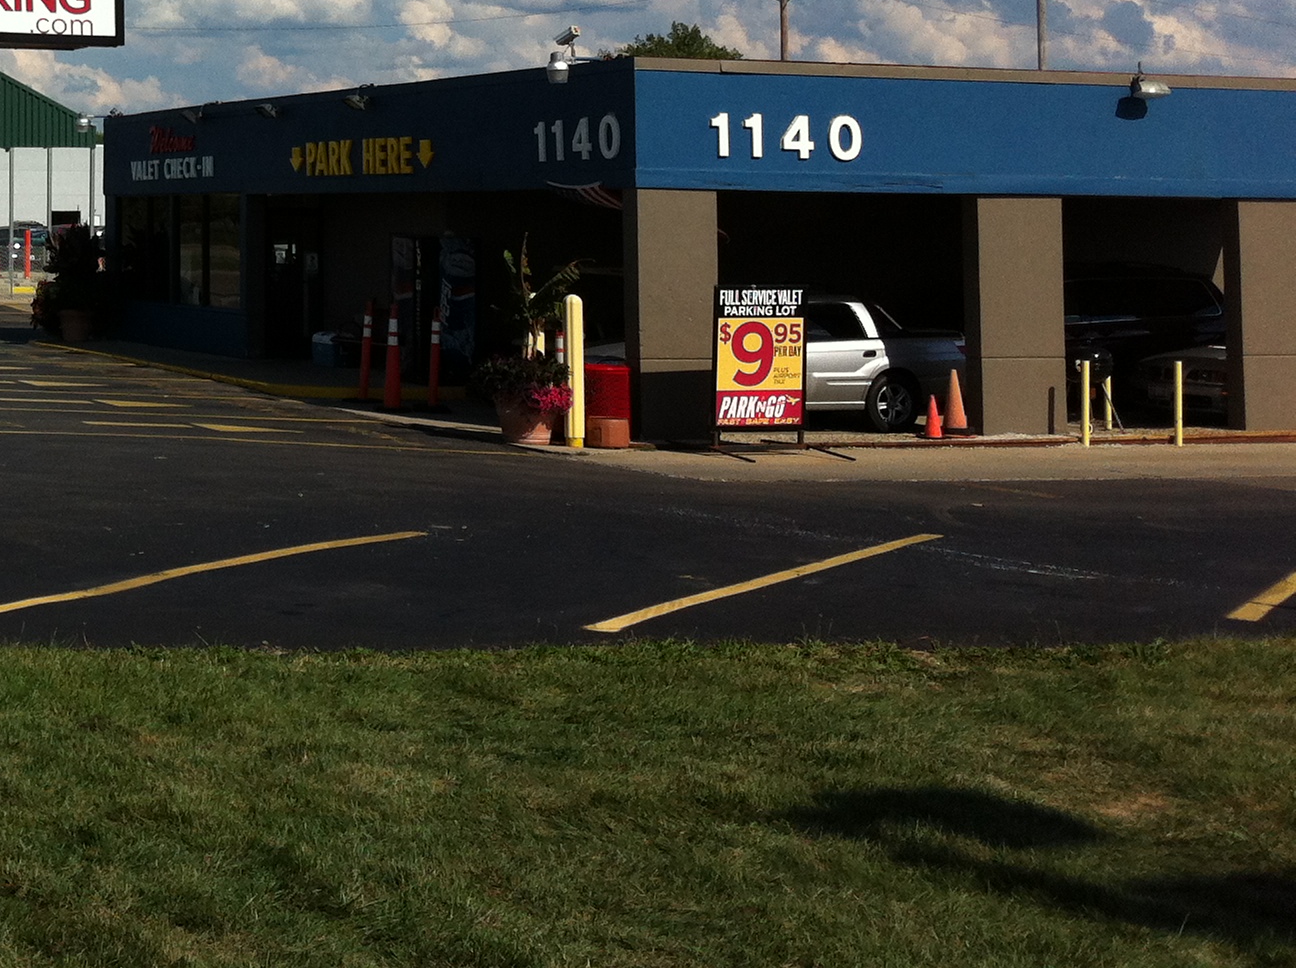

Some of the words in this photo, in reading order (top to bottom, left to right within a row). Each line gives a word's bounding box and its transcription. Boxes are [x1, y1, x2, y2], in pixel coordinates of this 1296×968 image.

[533, 113, 621, 163] 1140
[709, 112, 862, 162] 1140
[305, 140, 353, 176] PARK
[362, 137, 414, 175] HERE
[130, 160, 160, 181] VALET
[720, 290, 740, 305] FULL
[741, 290, 777, 305] SERVICE
[777, 290, 803, 305] VALET
[724, 306, 773, 316] PARKING
[776, 306, 797, 316] LOT
[774, 346, 787, 357] PER
[789, 346, 802, 357] DAY
[718, 396, 759, 418] PARK
[765, 395, 786, 418] GO
